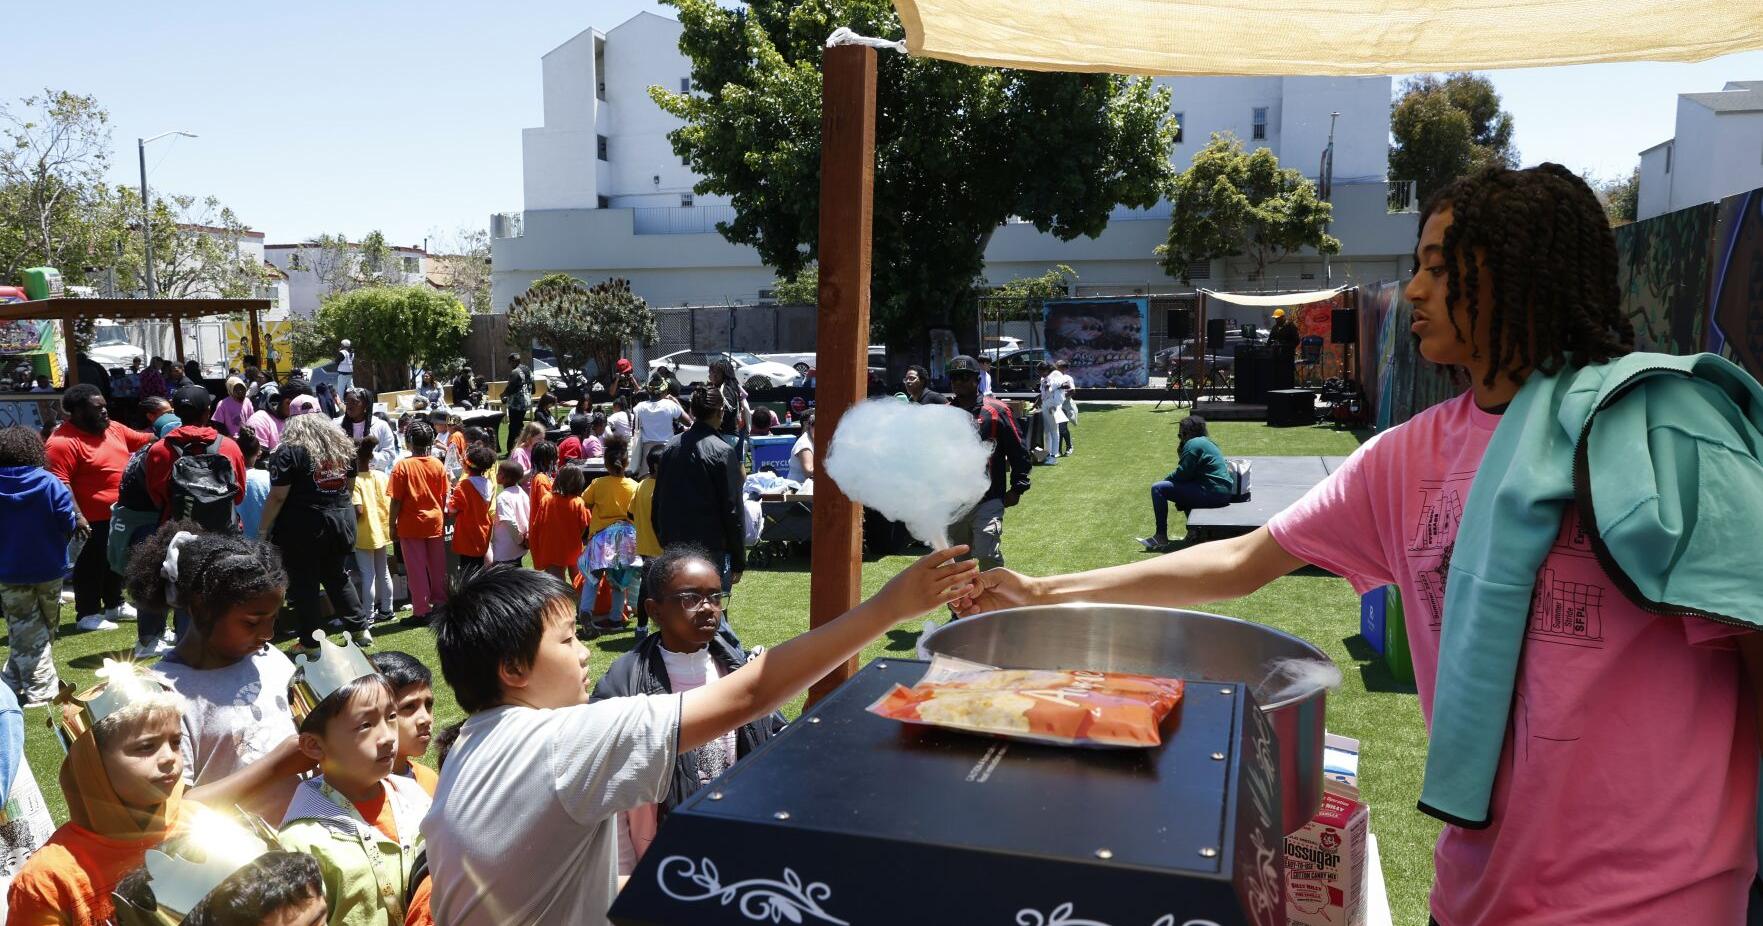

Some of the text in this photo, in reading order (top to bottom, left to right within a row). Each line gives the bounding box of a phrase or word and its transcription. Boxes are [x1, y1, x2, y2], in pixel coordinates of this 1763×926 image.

[761, 460, 789, 468] RECYCL
[1552, 601, 1562, 629] Summer
[1564, 607, 1574, 627] Stride
[1575, 606, 1585, 632] SFPL
[1284, 838, 1340, 870] lossugar
